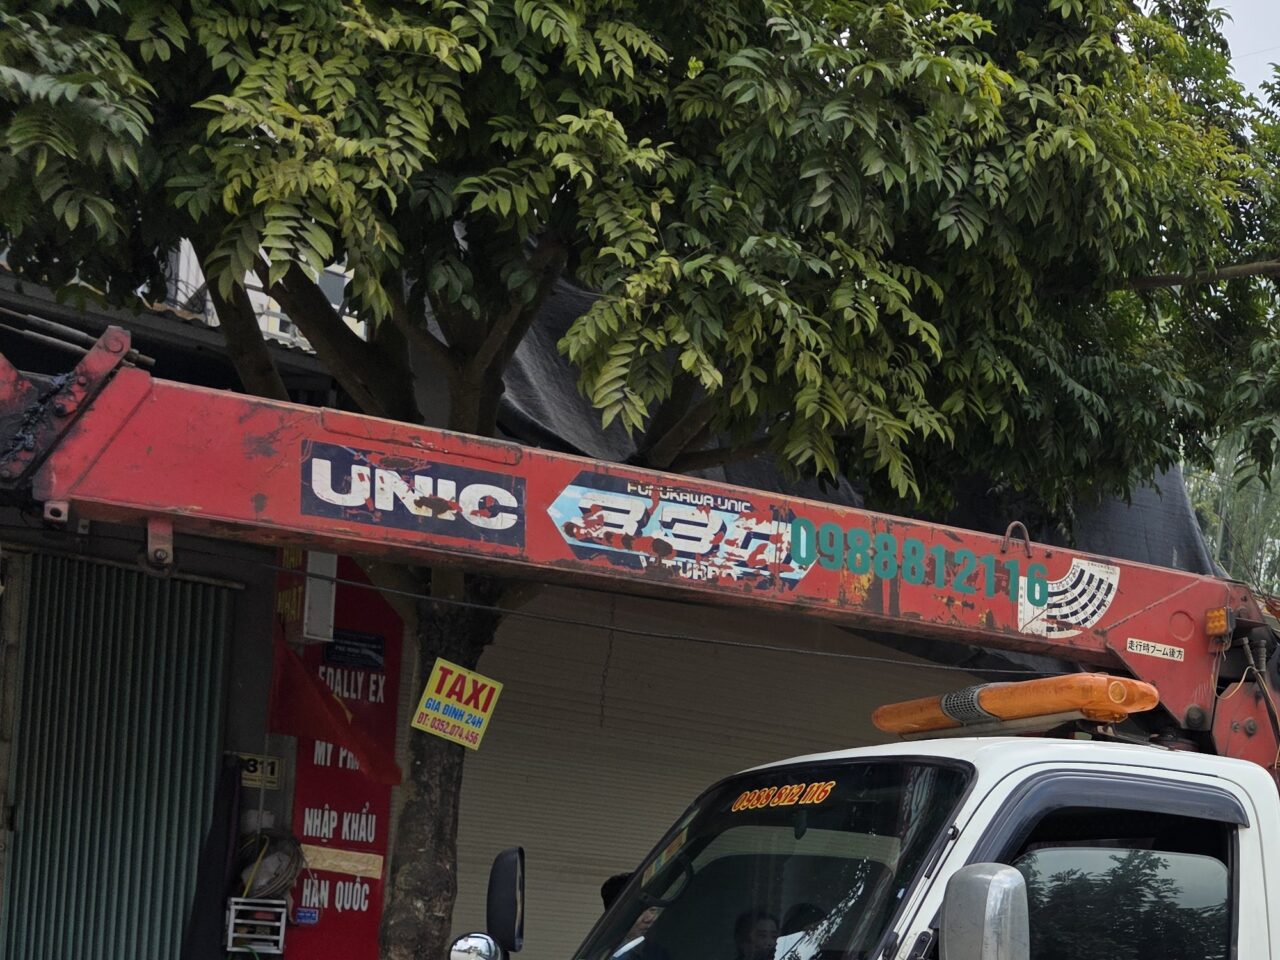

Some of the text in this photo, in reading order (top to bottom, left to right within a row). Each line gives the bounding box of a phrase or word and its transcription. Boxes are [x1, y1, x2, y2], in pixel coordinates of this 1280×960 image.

[311, 457, 518, 530] UNIC
[717, 498, 752, 513] UNIC
[791, 517, 1048, 608] 0988812116
[1128, 640, 1184, 660] 走行時ブーム後方
[369, 674, 386, 703] EX
[434, 666, 496, 713] TAXI
[424, 697, 441, 713] GIA
[464, 713, 484, 729] 24H
[731, 780, 836, 812] 0988 812 116
[303, 801, 376, 843] NHẬP KHẨU
[301, 873, 329, 909] HÀN
